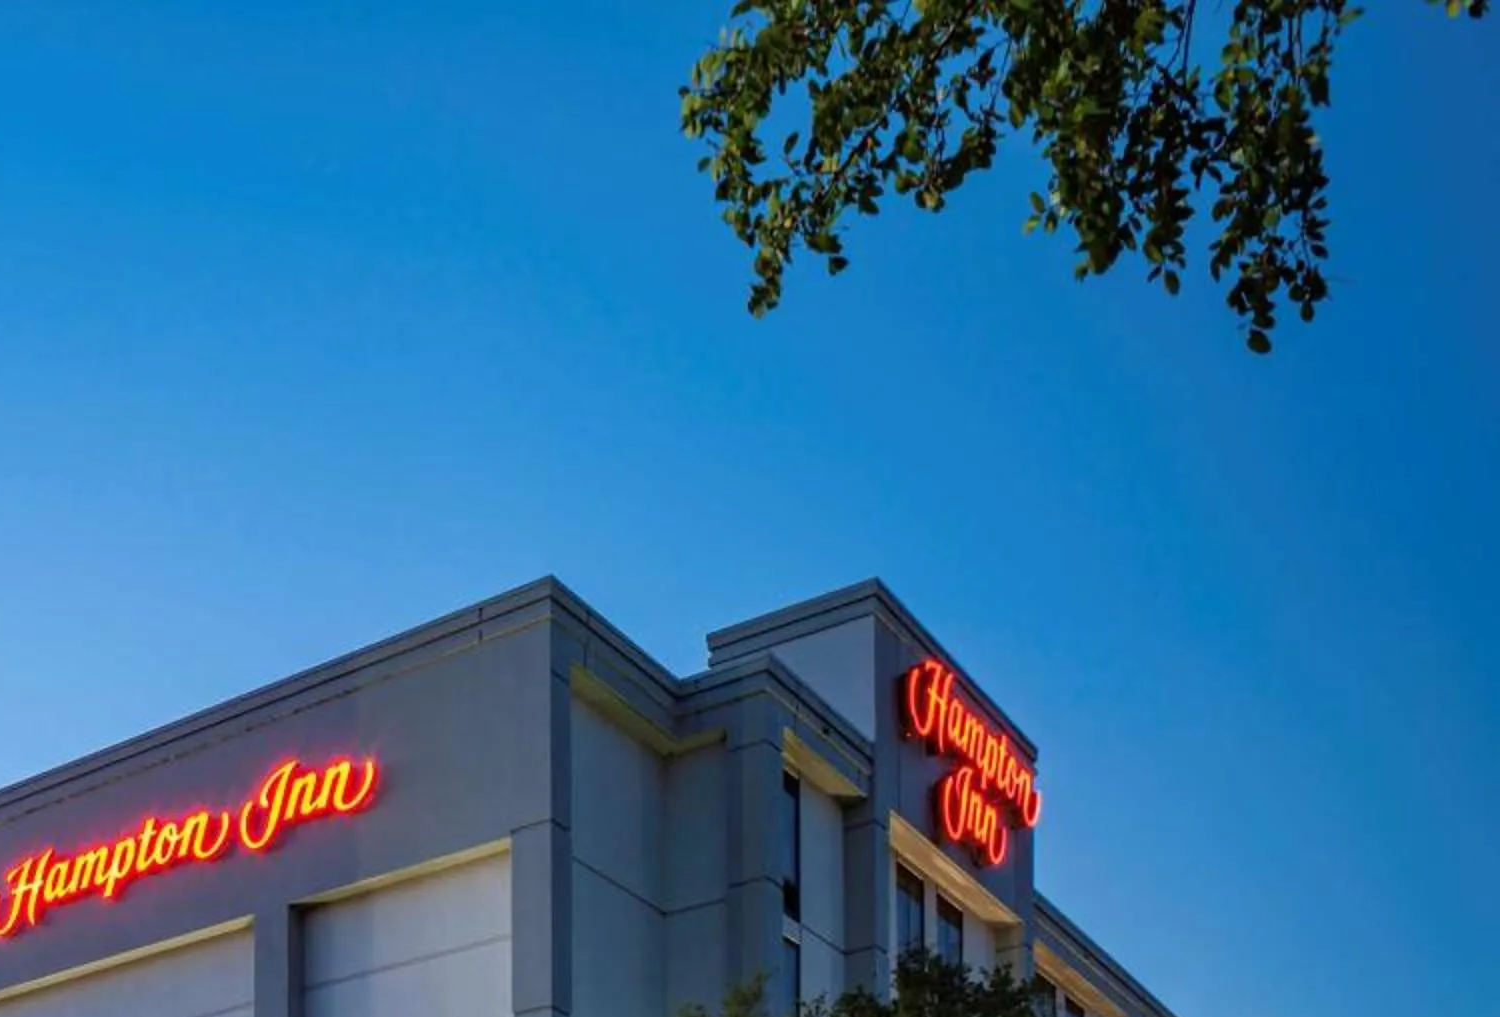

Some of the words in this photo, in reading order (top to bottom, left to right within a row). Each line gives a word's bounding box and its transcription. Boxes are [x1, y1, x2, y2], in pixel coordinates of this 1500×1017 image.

[908, 659, 1041, 828] Hampton
[240, 758, 376, 850] Inn
[944, 767, 1008, 865] Inn
